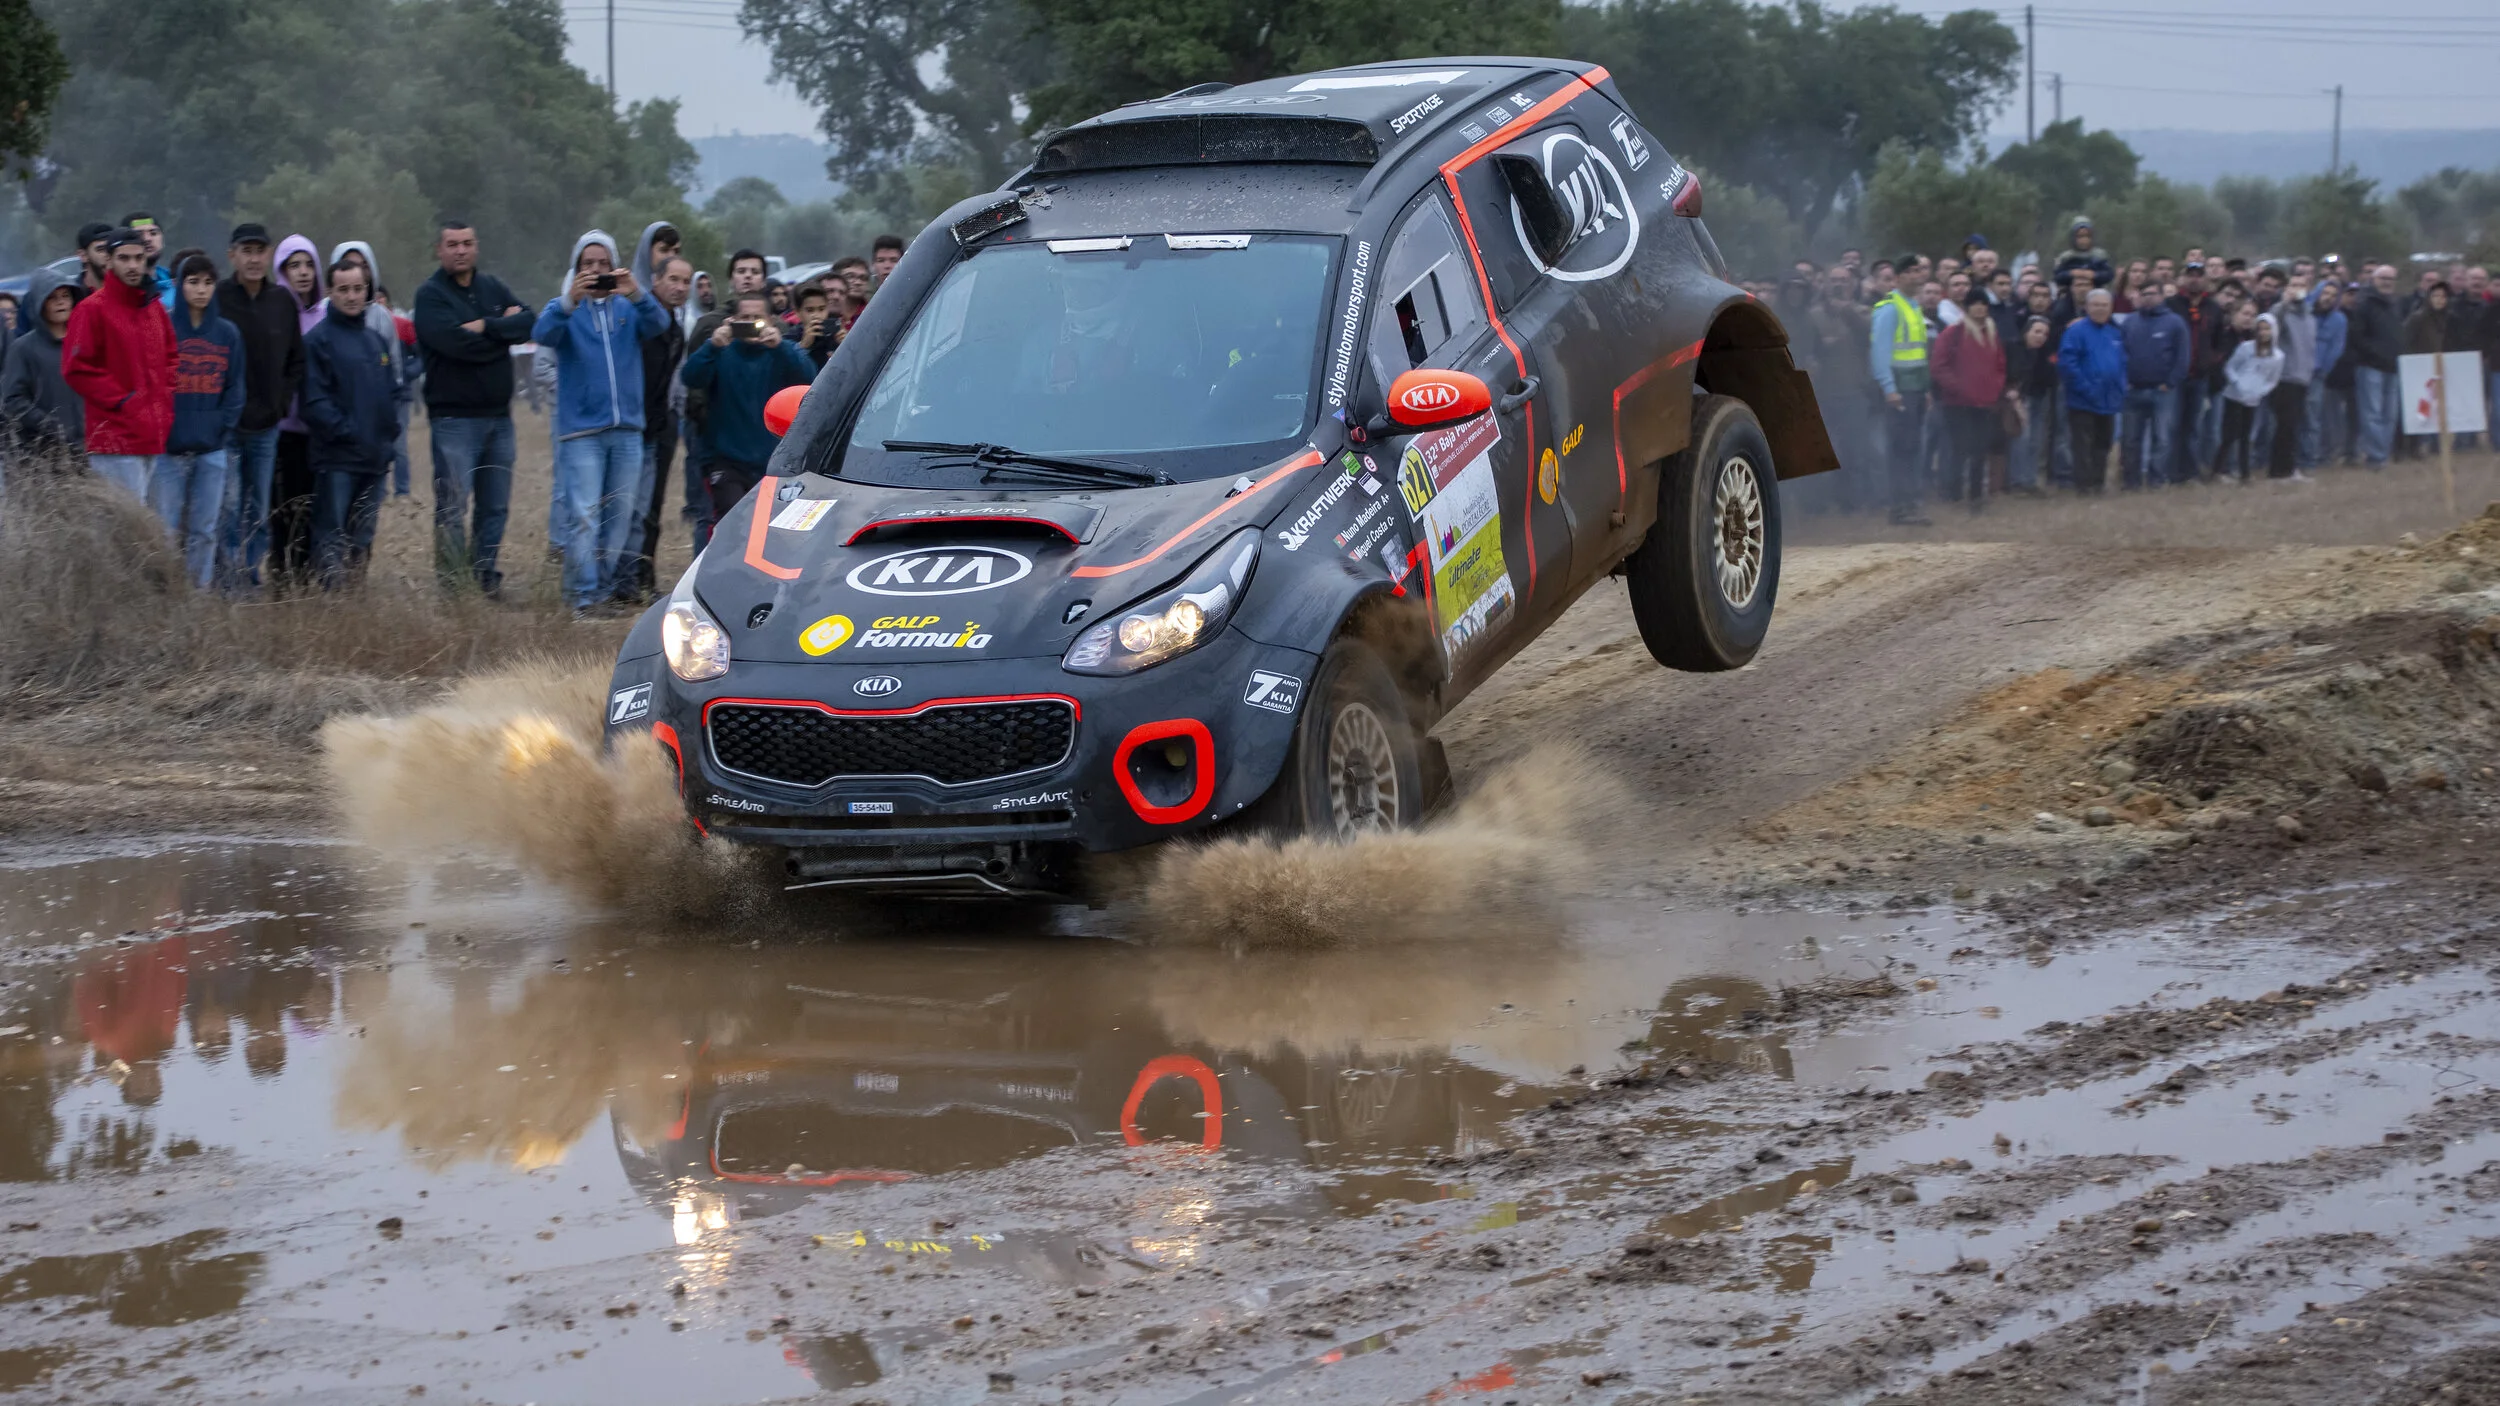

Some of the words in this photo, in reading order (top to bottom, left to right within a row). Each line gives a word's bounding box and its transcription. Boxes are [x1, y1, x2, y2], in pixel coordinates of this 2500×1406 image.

[1390, 94, 1444, 134] SPORTAGE
[1612, 122, 1637, 167] 7
[1630, 136, 1643, 151] KIA
[1329, 240, 1371, 407] styleautomotorsport.com
[1411, 388, 1451, 406] KIA
[1439, 431, 1456, 452] Baja
[1562, 423, 1584, 457] GALP
[1291, 469, 1356, 534] KRAFTWERK
[1341, 523, 1359, 542] Nuno
[1356, 500, 1382, 528] Madeira
[1381, 493, 1389, 506] A+
[1354, 536, 1371, 559] Miguel
[1370, 522, 1388, 543] Costa
[873, 557, 994, 585] KIA
[1448, 546, 1481, 588] ultimate
[854, 622, 994, 649] Formula
[872, 616, 941, 629] GALP
[860, 678, 892, 692] KIA
[1246, 672, 1283, 703] 7
[1270, 691, 1292, 704] KIA
[613, 689, 638, 720] 7
[630, 699, 648, 710] KIA
[1262, 700, 1291, 712] GARANTIA
[711, 794, 765, 812] STYLEAUTO
[853, 803, 892, 812] 35-54-NU
